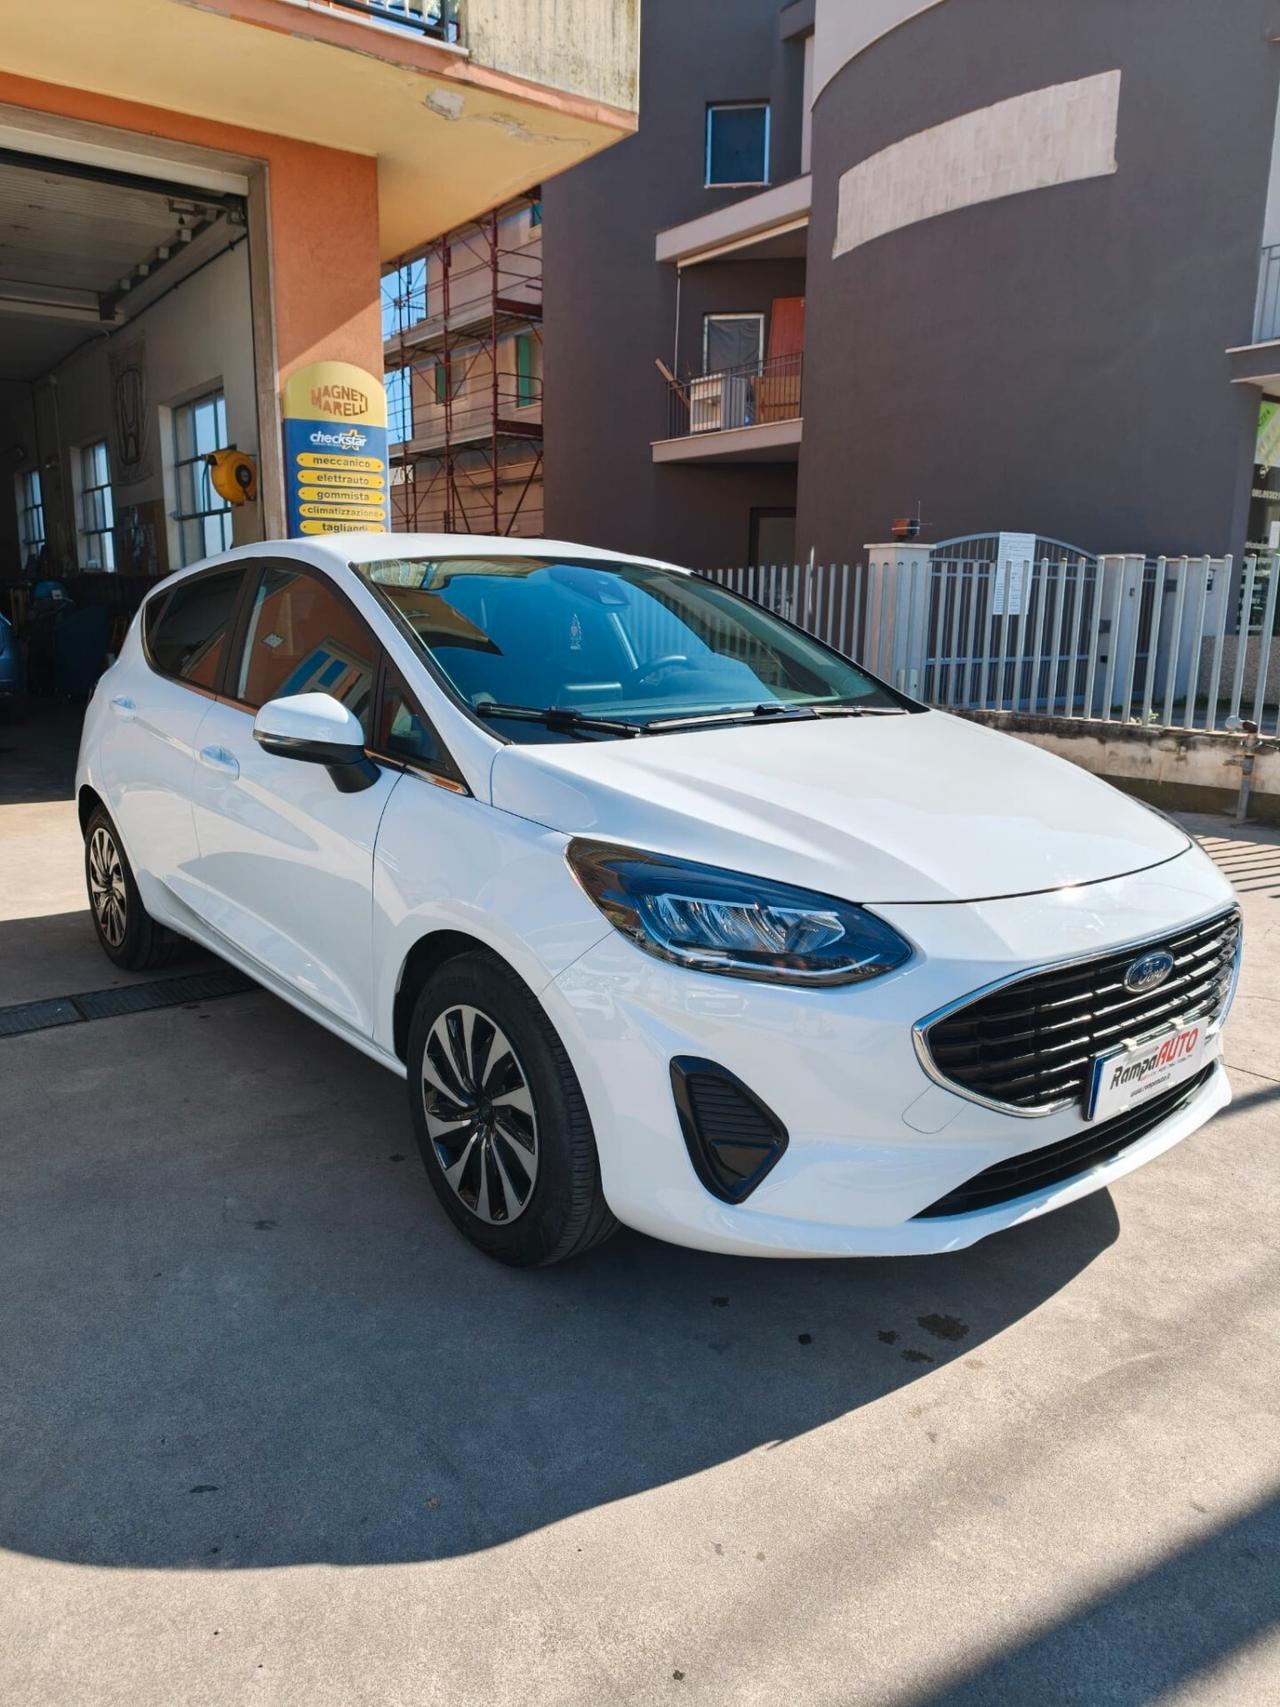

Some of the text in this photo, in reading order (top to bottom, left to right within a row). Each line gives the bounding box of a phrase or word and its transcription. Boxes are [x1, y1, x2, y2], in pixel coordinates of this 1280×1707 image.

[311, 384, 368, 402] MAGNETI
[311, 400, 368, 417] MARELLI
[310, 430, 367, 447] checkstar
[313, 456, 371, 468] meccanico
[316, 474, 369, 486] elettrauto
[316, 491, 370, 502] gommista
[306, 506, 379, 517] climatizzazione
[1137, 960, 1167, 985] Ford
